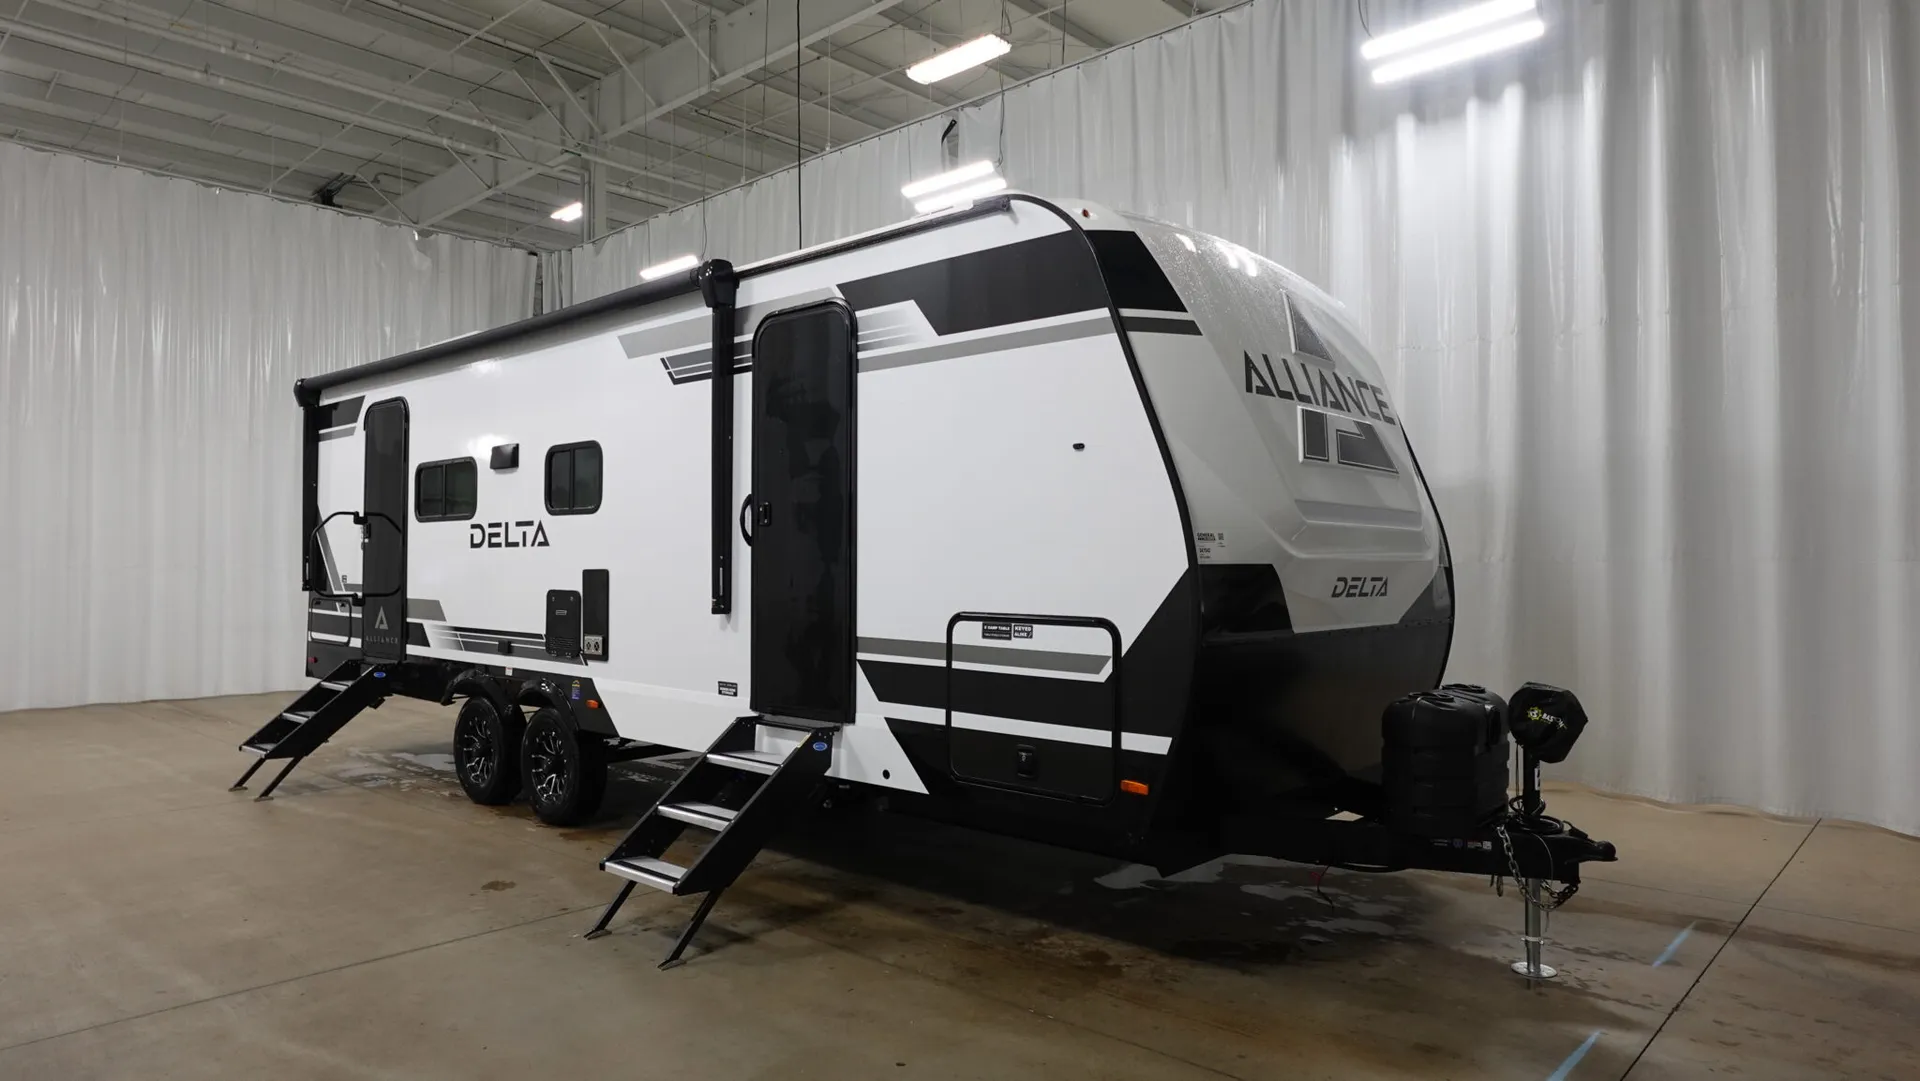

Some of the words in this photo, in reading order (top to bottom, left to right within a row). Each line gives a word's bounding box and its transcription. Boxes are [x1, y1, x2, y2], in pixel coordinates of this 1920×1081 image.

[1244, 350, 1396, 426] ALLIANCE
[470, 520, 550, 549] DELTA
[1331, 576, 1389, 599] DELTA
